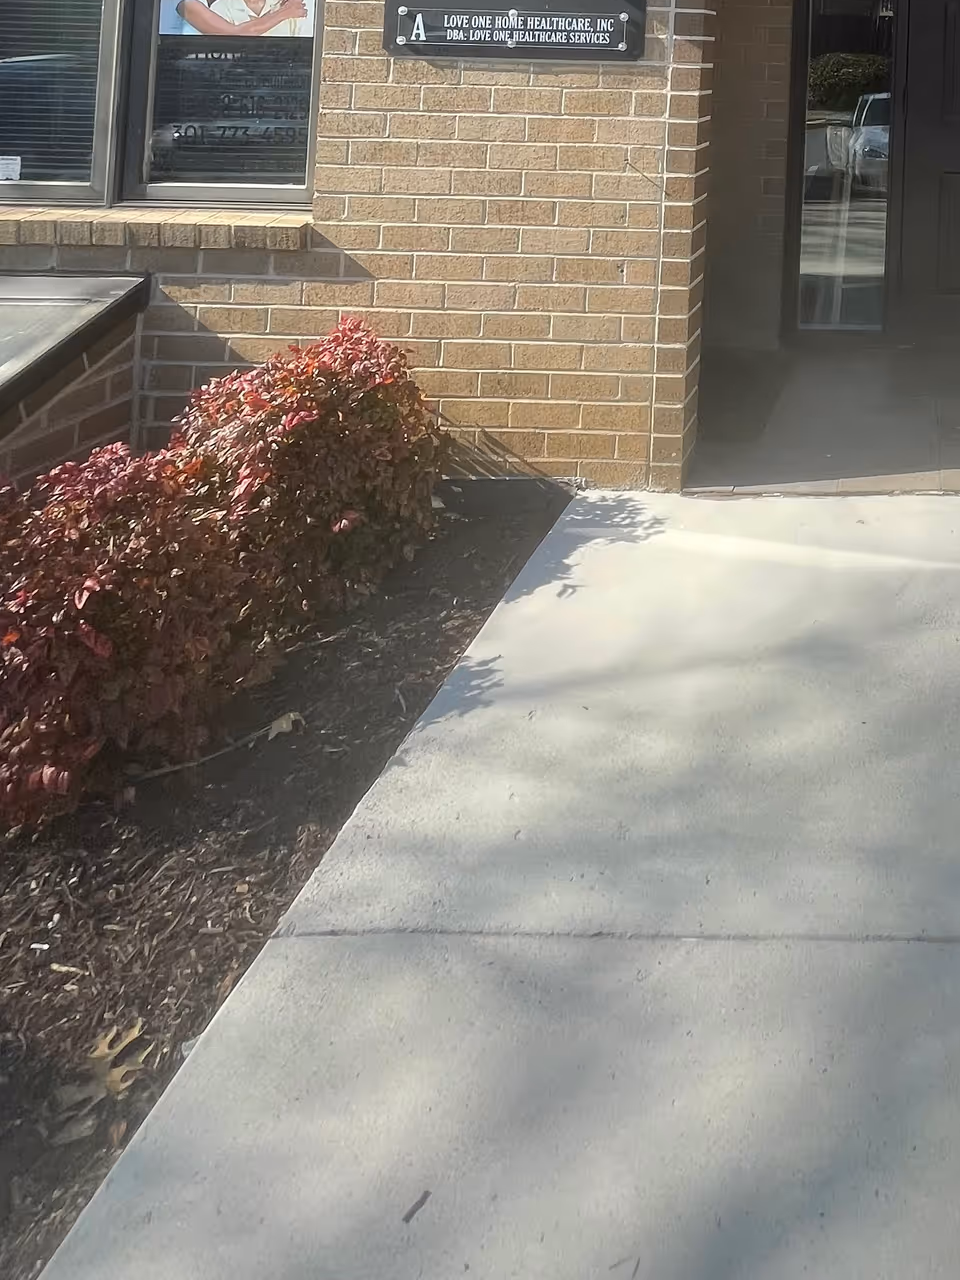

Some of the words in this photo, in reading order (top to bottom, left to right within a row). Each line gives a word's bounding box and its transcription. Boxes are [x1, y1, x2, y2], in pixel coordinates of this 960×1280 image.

[410, 13, 427, 42] A
[443, 14, 469, 28] LOVE
[471, 15, 492, 29] ONE
[495, 16, 524, 30] HOME
[527, 16, 594, 33] HEALTHCARE,
[596, 18, 614, 32] INC
[446, 29, 467, 40] DBA:
[469, 29, 491, 41] LOVE
[492, 30, 511, 42] ONE
[512, 30, 568, 43] HEALTHCARE
[569, 32, 610, 44] SERVICES
